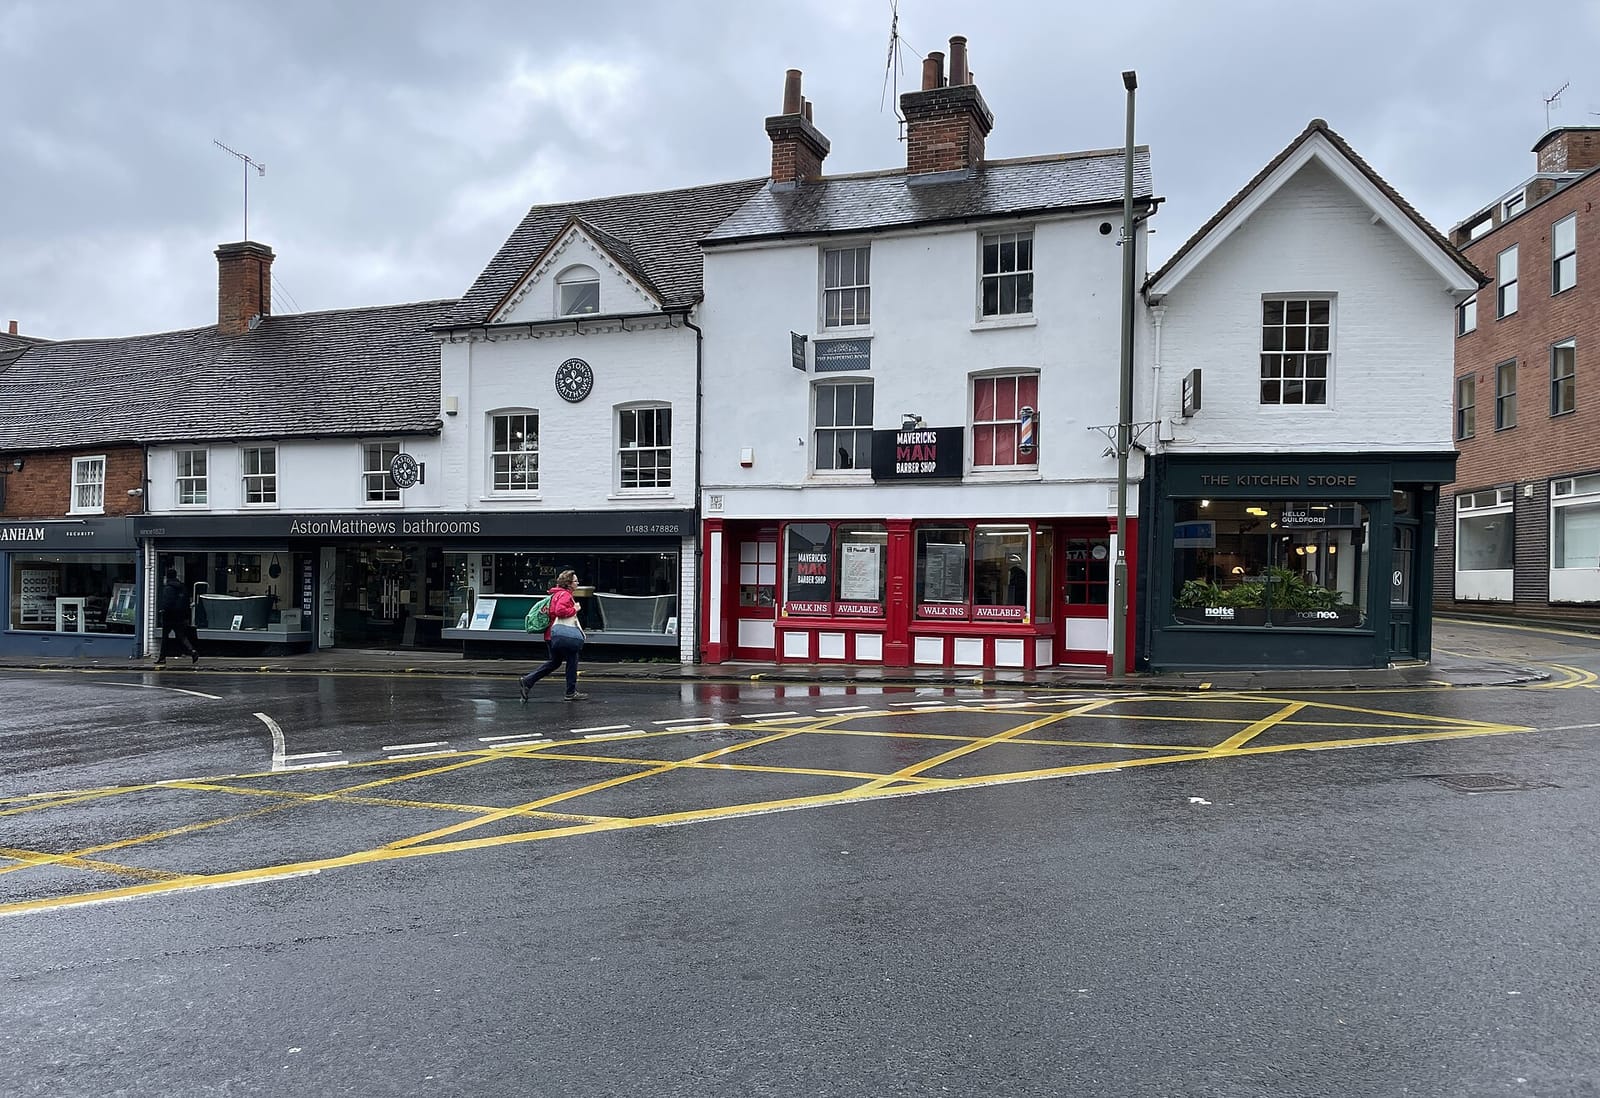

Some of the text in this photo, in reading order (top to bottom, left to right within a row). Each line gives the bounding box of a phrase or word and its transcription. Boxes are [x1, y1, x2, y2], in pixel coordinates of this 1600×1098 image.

[562, 362, 586, 374] ASTON
[559, 378, 589, 398] MATTHEWS
[896, 432, 937, 445] MAVERICKS
[896, 445, 937, 461] MAN
[896, 462, 936, 474] BARBER SHOP
[1201, 475, 1357, 486] THE KITCHEN STORE
[290, 519, 480, 534] AstonMatthews bathrooms
[625, 525, 679, 533] 01483 478826
[0, 528, 45, 541] ANHAM
[798, 553, 827, 563] MAVERICKS
[797, 563, 827, 575] MAN
[797, 575, 827, 584] BARBER SHOP
[791, 603, 878, 613] WALK INS AVAILABLE
[923, 606, 1021, 617] WALK INS AVAILABLE
[1205, 606, 1235, 615] nolte
